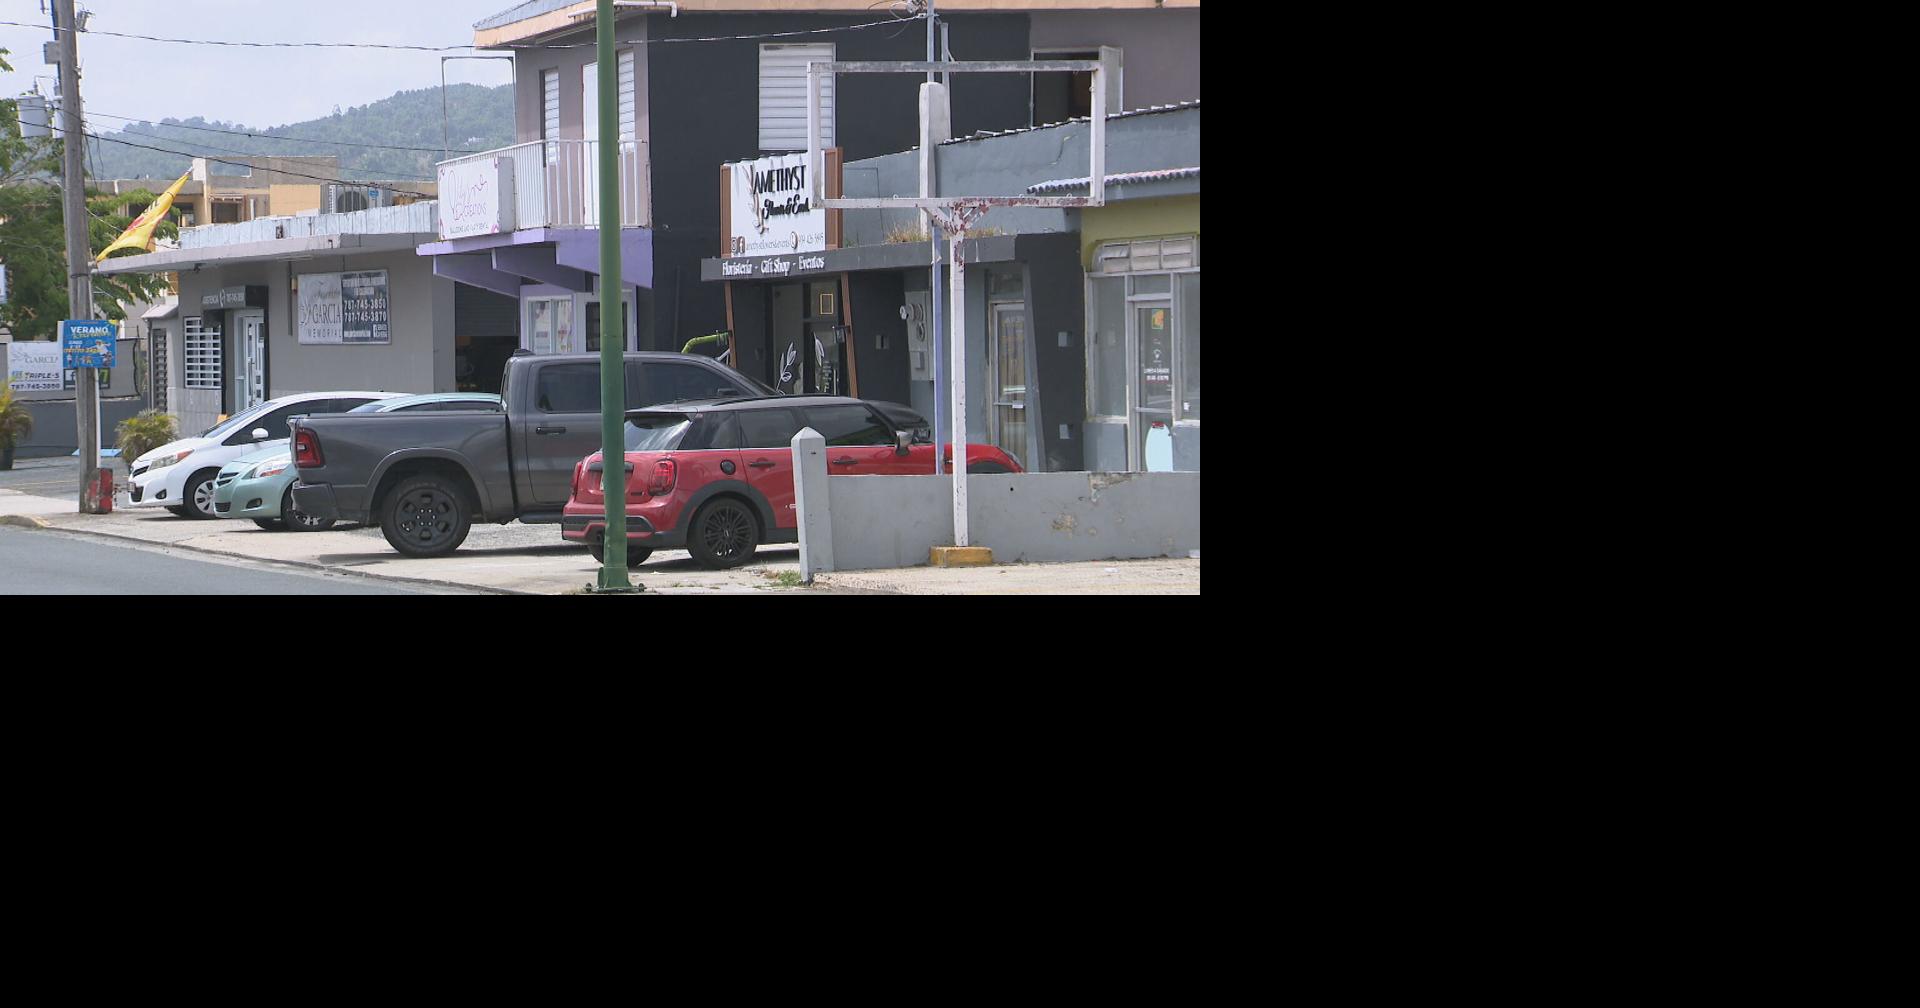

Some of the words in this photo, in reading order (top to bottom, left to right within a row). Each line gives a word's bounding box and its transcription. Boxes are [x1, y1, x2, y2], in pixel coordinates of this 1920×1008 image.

[753, 165, 807, 195] AMETHYST
[760, 258, 773, 273] Gift
[773, 257, 791, 277] Shop
[798, 255, 825, 270] Eventos
[344, 298, 386, 310] 787-745-3850
[344, 311, 387, 322] 787-745-3870
[70, 326, 108, 334] VERANO
[307, 328, 342, 338] MEMORIAL
